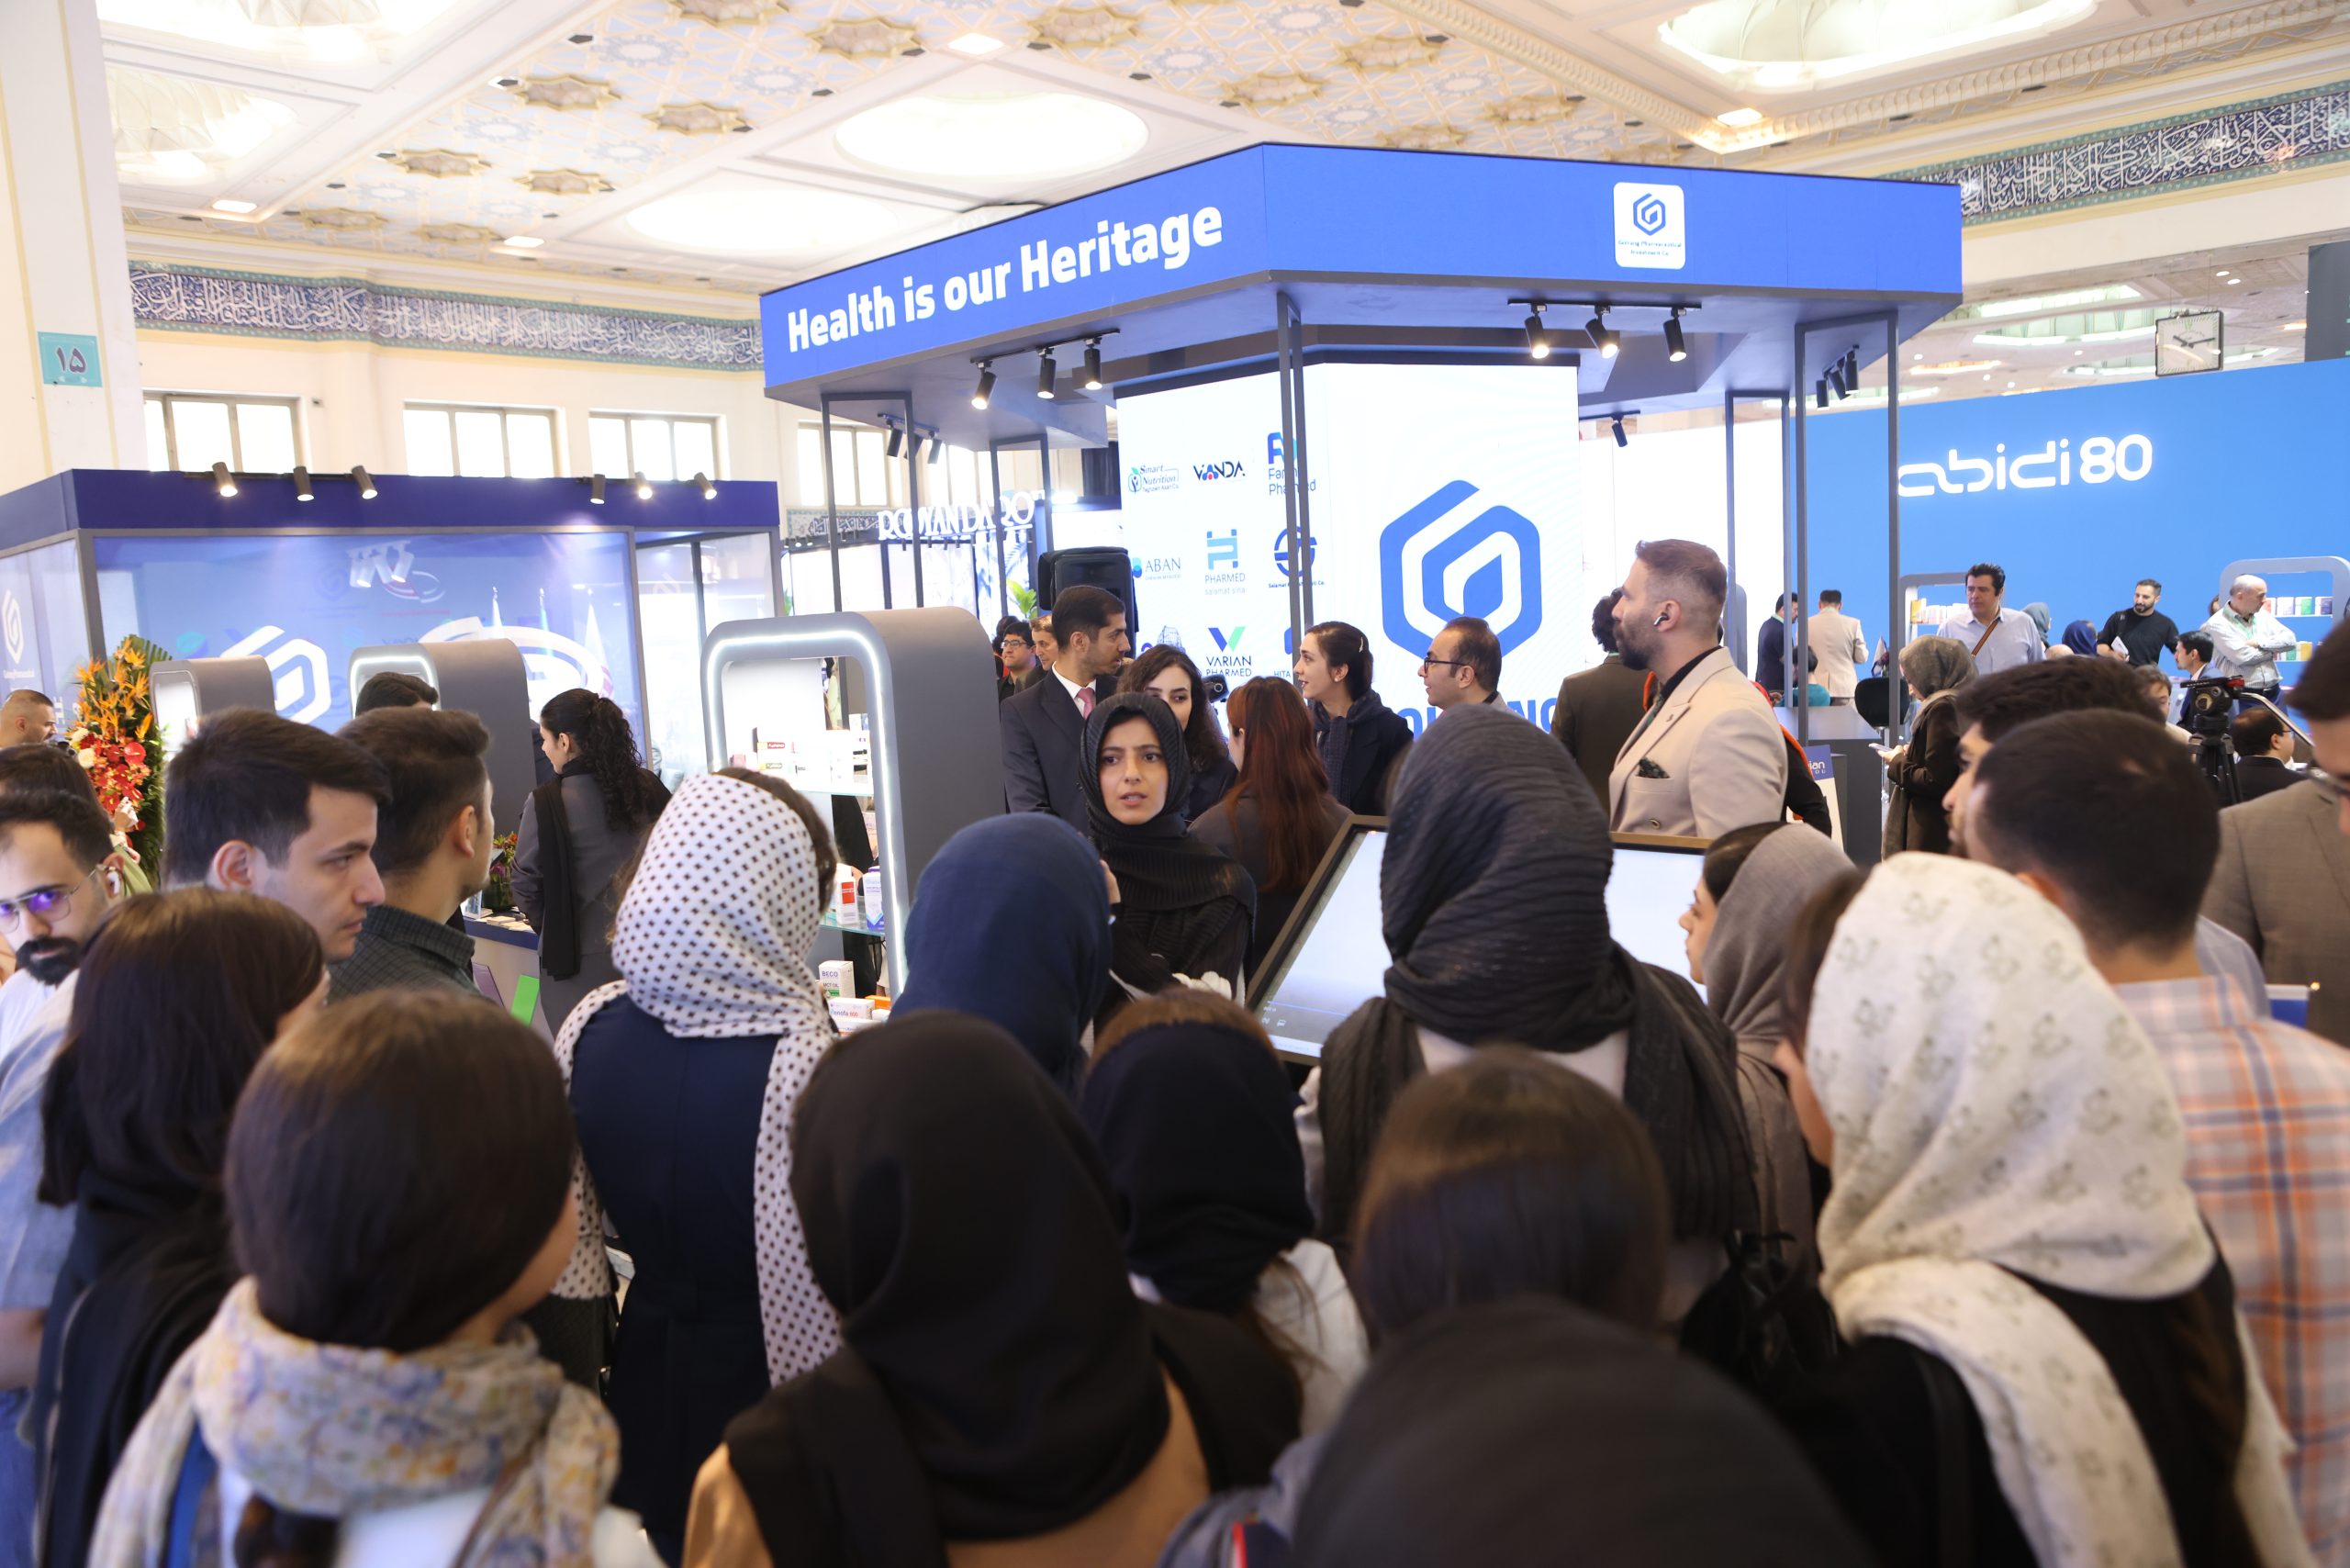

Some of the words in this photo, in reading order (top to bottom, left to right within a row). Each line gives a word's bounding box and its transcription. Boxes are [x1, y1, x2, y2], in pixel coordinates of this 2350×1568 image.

[789, 285, 895, 353] Health
[903, 275, 934, 323] is
[944, 262, 1012, 311] our
[1021, 207, 1223, 292] Heritage
[57, 347, 86, 373] ۱۵
[1140, 465, 1163, 475] Smart
[1898, 438, 2069, 497] abidi
[2079, 433, 2153, 484] 80
[1143, 475, 1176, 486] Nutrition
[1146, 556, 1181, 573] ABAN
[1204, 573, 1246, 585] PHARMED
[1206, 655, 1252, 666] VARIAN
[1206, 668, 1252, 677] PHARMED
